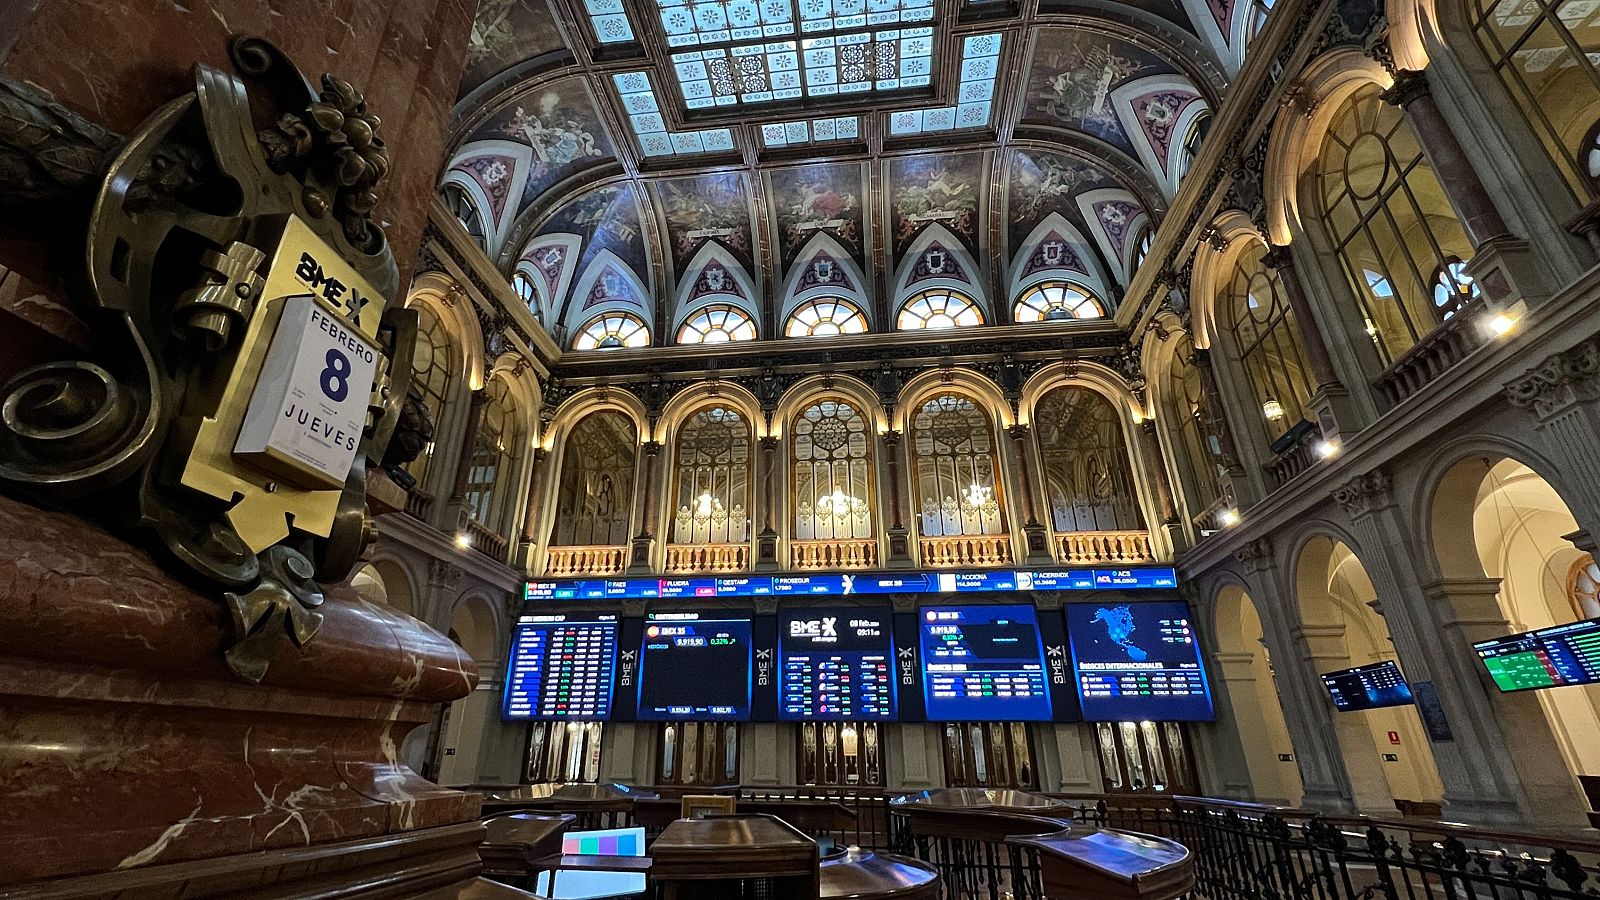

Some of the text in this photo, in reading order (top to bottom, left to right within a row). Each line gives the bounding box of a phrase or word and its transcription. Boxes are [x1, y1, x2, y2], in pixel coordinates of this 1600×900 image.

[311, 310, 373, 365] FEBRERO
[319, 348, 352, 403] 8
[284, 404, 355, 451] JUEVES
[677, 638, 704, 646] 9.919,90
